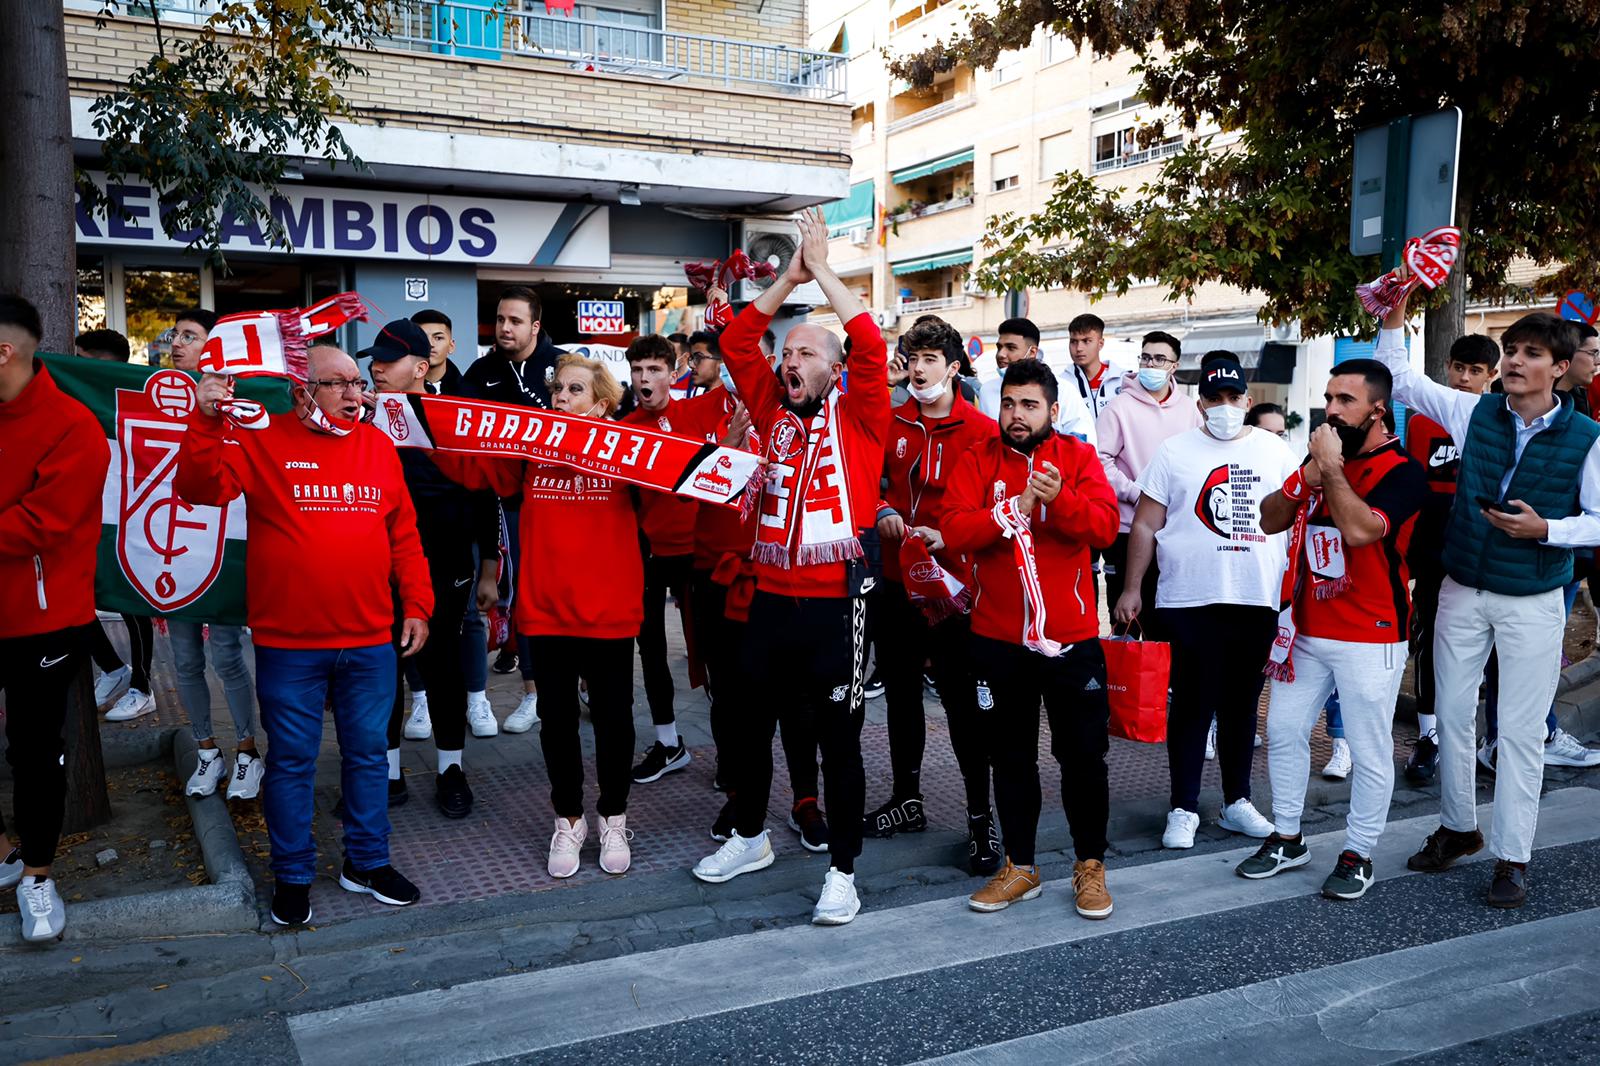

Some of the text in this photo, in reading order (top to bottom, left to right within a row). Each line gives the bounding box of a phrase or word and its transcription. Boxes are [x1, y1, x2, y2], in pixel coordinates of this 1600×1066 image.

[581, 303, 621, 317] LIQUI
[581, 318, 622, 331] MOLY
[1207, 368, 1239, 382] FILA
[455, 407, 663, 470] GRADA 1931
[480, 441, 622, 474] GRANADA CLUB DE FUTBOL
[533, 476, 611, 490] GRADA 1931
[293, 484, 381, 501] GRADA 1931
[1232, 512, 1255, 520] PALERMO
[1232, 526, 1256, 534] MARSELLA
[1240, 533, 1266, 543] PROFESOR
[876, 799, 923, 831] AIR
